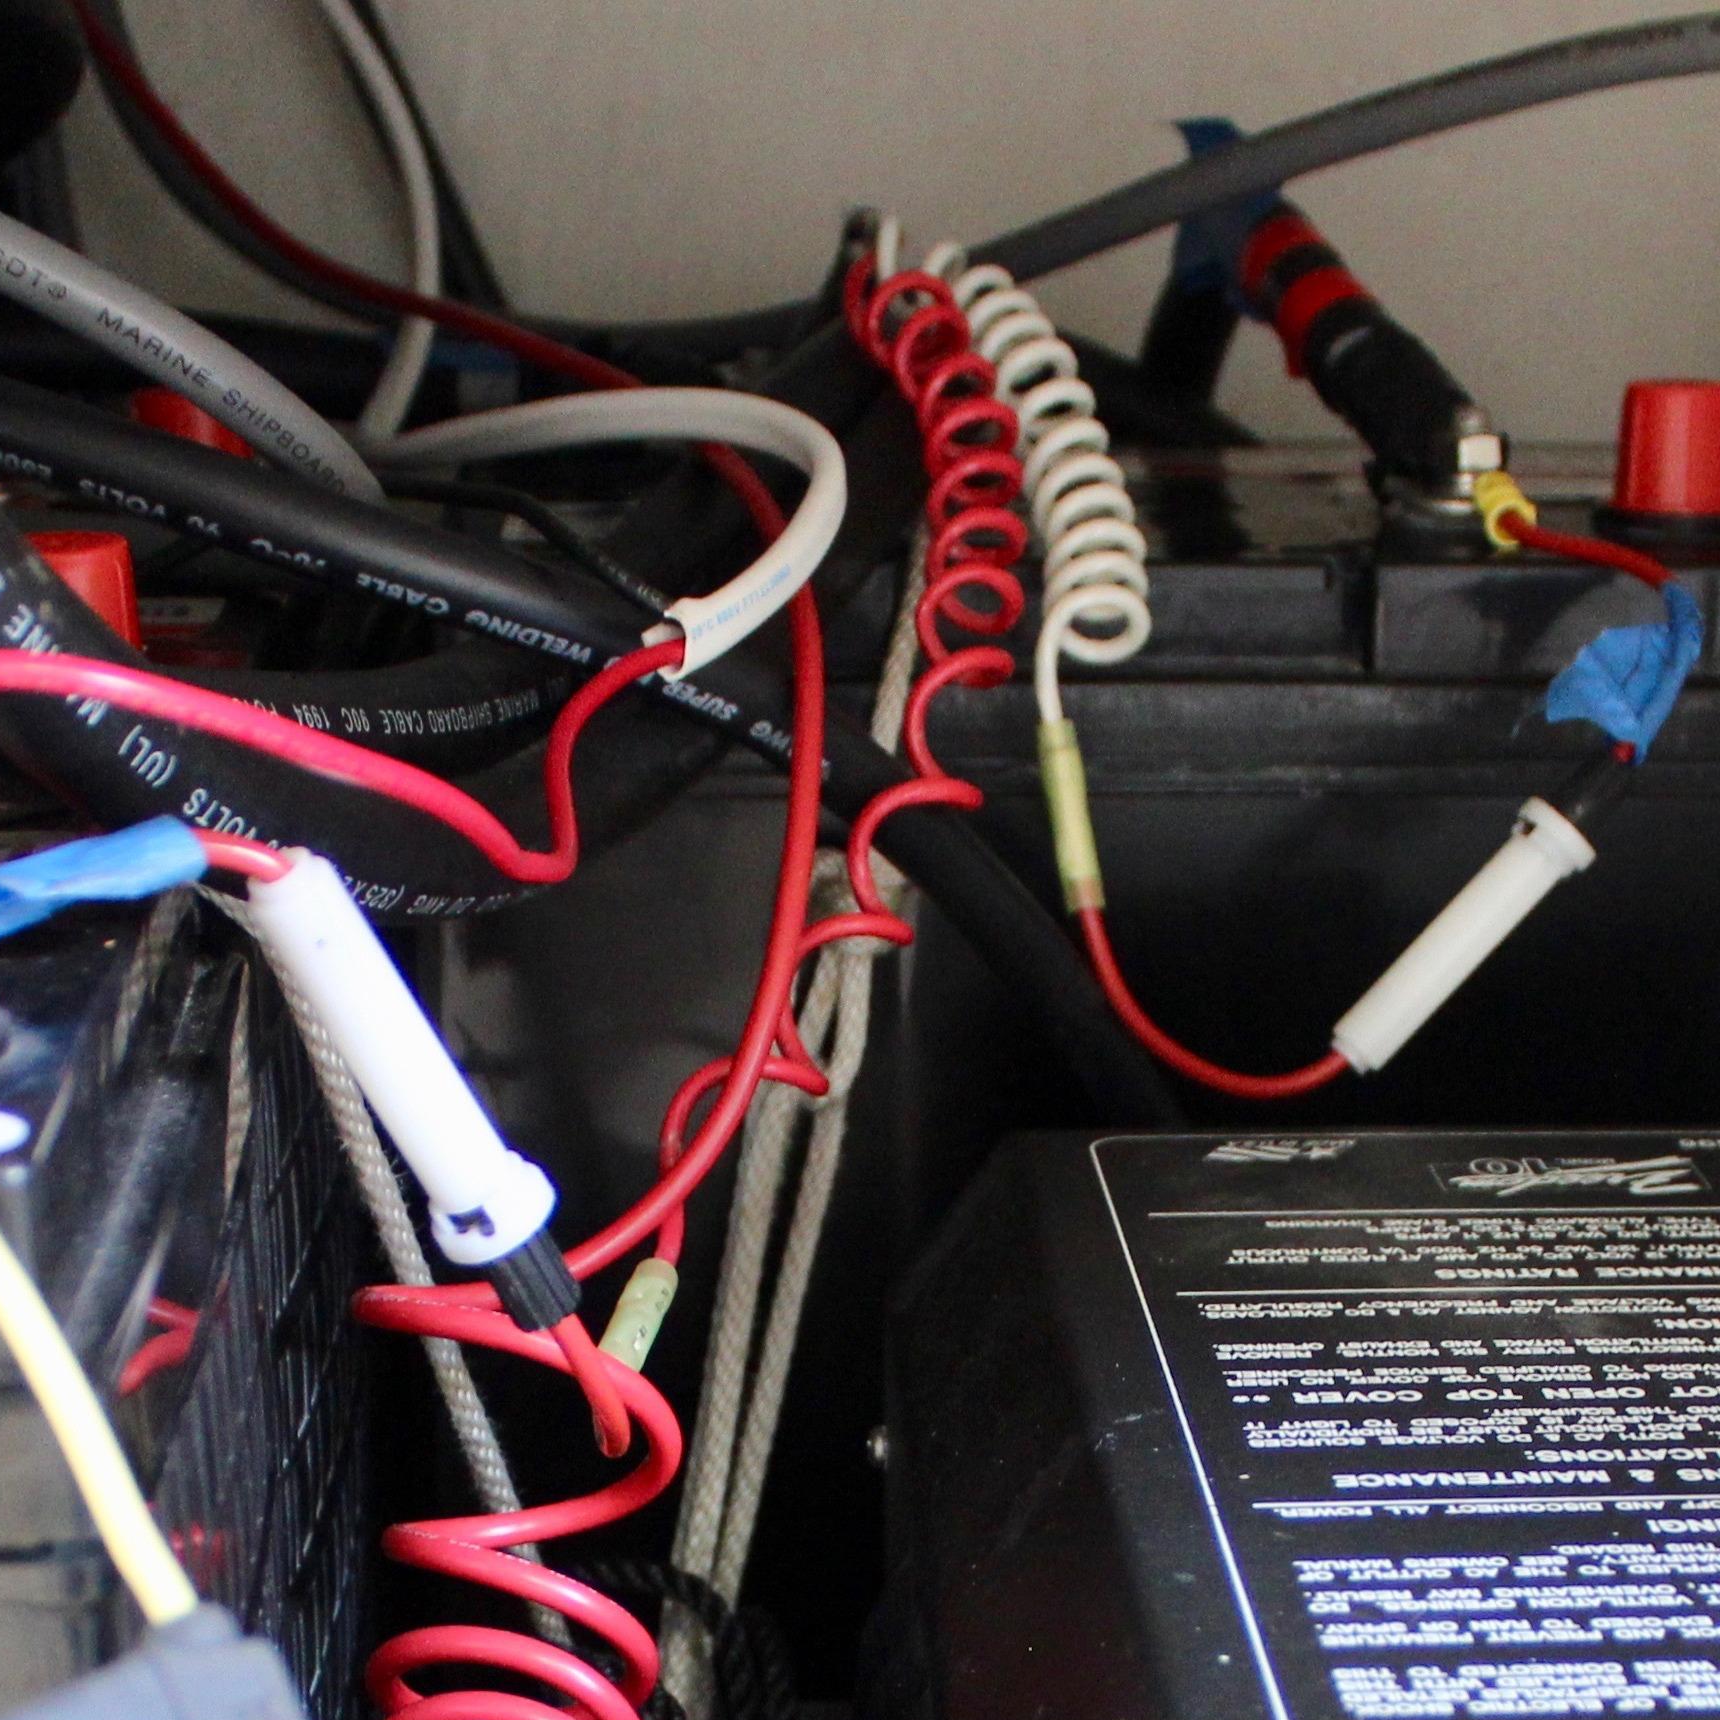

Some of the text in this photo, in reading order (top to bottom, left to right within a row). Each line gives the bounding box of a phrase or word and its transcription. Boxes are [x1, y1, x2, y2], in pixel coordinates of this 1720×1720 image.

[95, 305, 212, 390] MARINE
[356, 571, 451, 615] CABLE
[464, 608, 593, 665] WELDING
[662, 680, 740, 722] SUPER
[342, 706, 371, 733] 90C
[382, 707, 425, 735] CABLE
[427, 698, 496, 735] SHIPBOARD
[117, 724, 178, 788] (UL)
[1435, 1268, 1578, 1279] RATINGS
[1293, 1390, 1422, 1404] COVER
[1446, 1389, 1523, 1400] TOP
[1542, 1387, 1645, 1399] OPEN
[1332, 1470, 1610, 1488] MAINTENANCE
[1629, 1469, 1654, 1482] &
